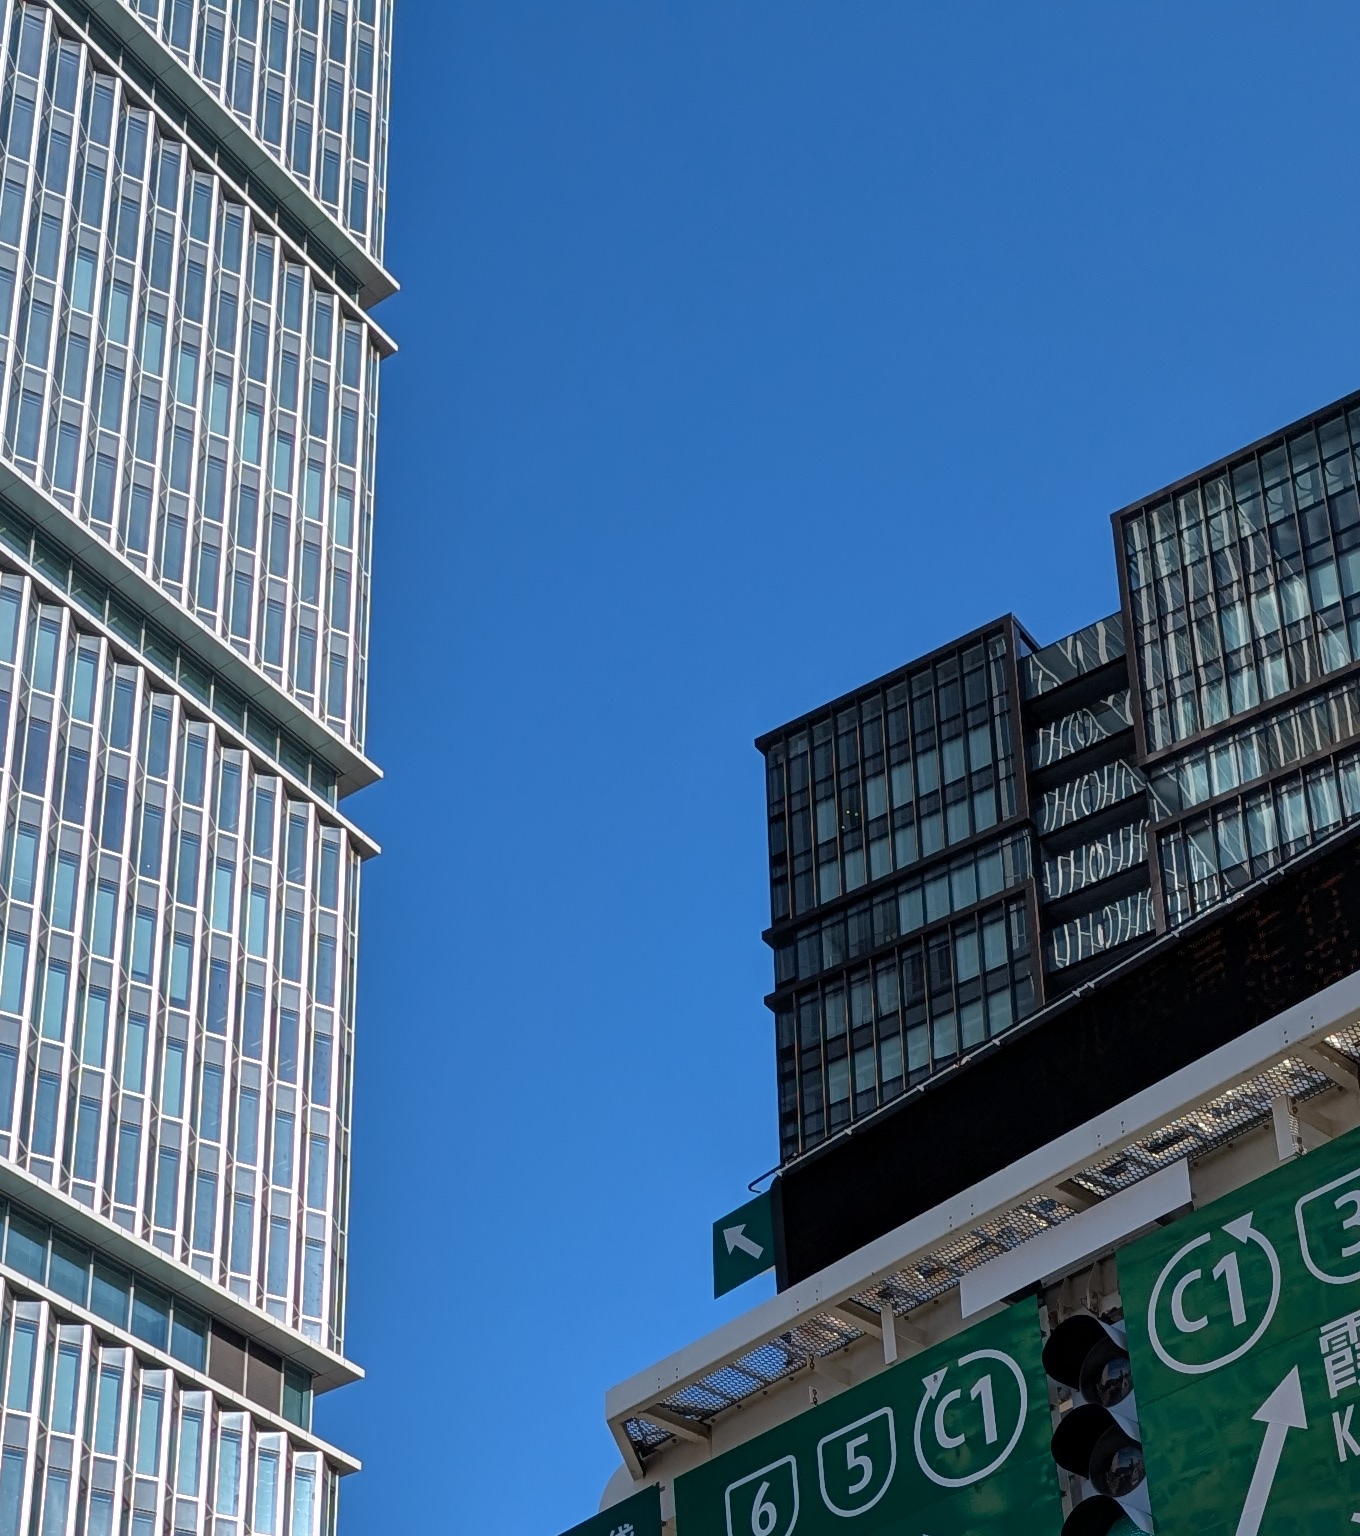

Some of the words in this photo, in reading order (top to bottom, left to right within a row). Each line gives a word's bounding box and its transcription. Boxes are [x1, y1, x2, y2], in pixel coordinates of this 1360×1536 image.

[1170, 1251, 1247, 1333] C1
[846, 1433, 873, 1495] 5
[934, 1373, 998, 1449] C1
